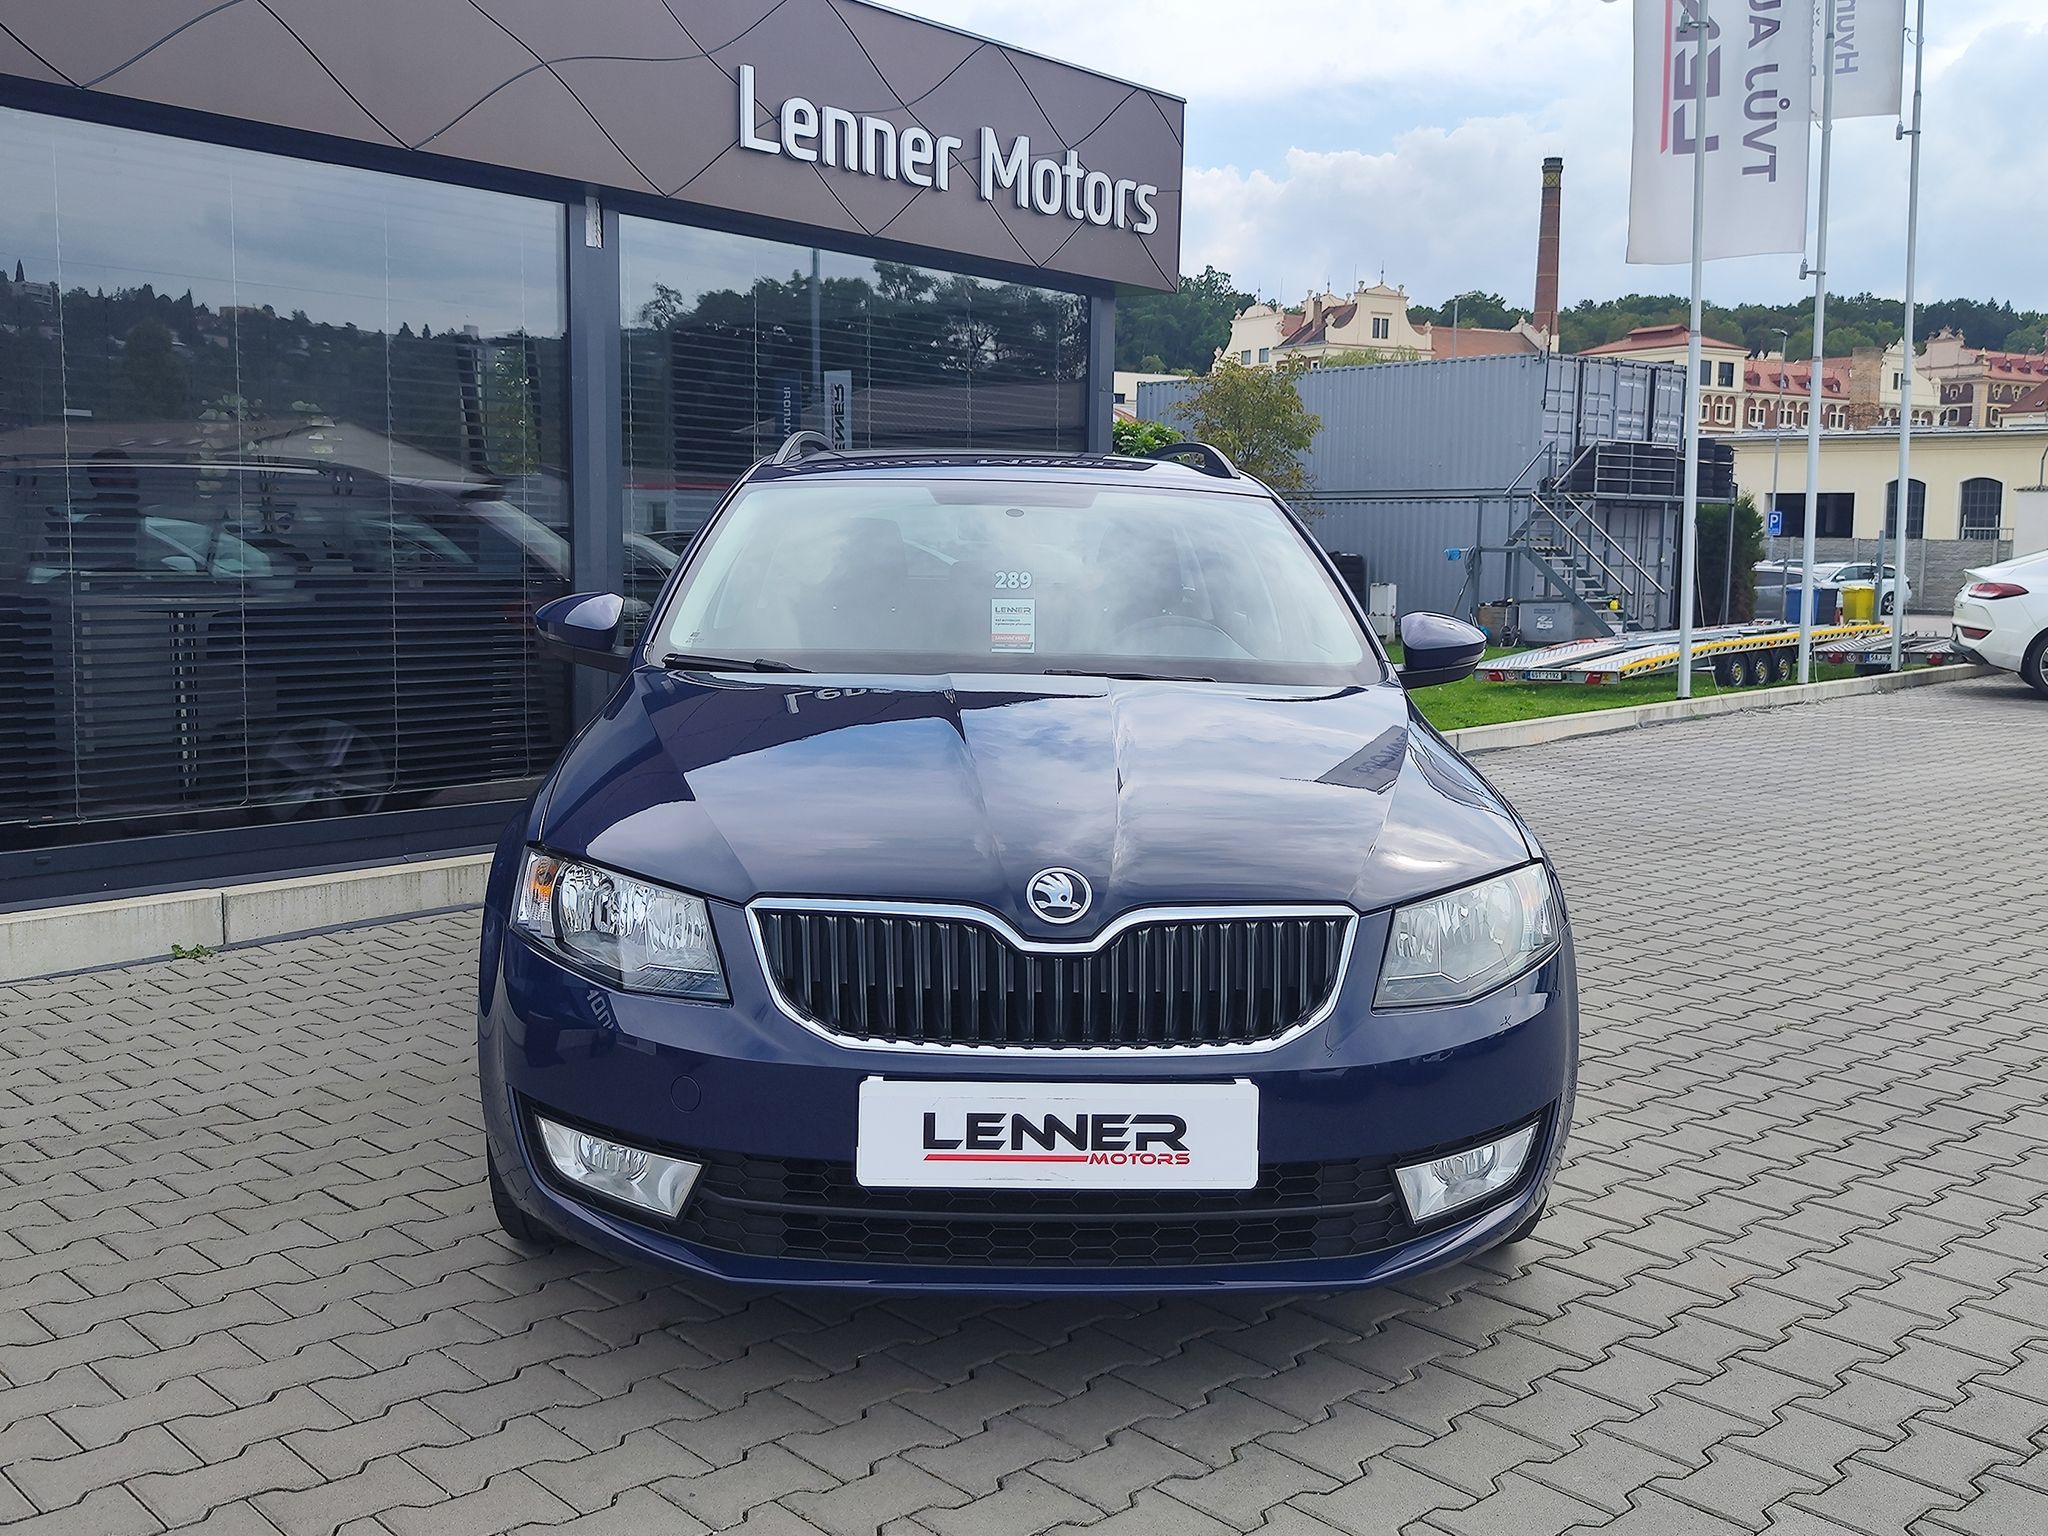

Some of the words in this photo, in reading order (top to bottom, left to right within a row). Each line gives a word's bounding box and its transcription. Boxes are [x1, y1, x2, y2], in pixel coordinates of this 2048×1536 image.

[738, 64, 963, 192] Lenner
[979, 126, 1159, 235] Motors
[1770, 514, 1779, 529] P
[994, 570, 1033, 589] 289
[923, 1112, 1190, 1151] LENNER
[1089, 1151, 1190, 1165] MOTORS
